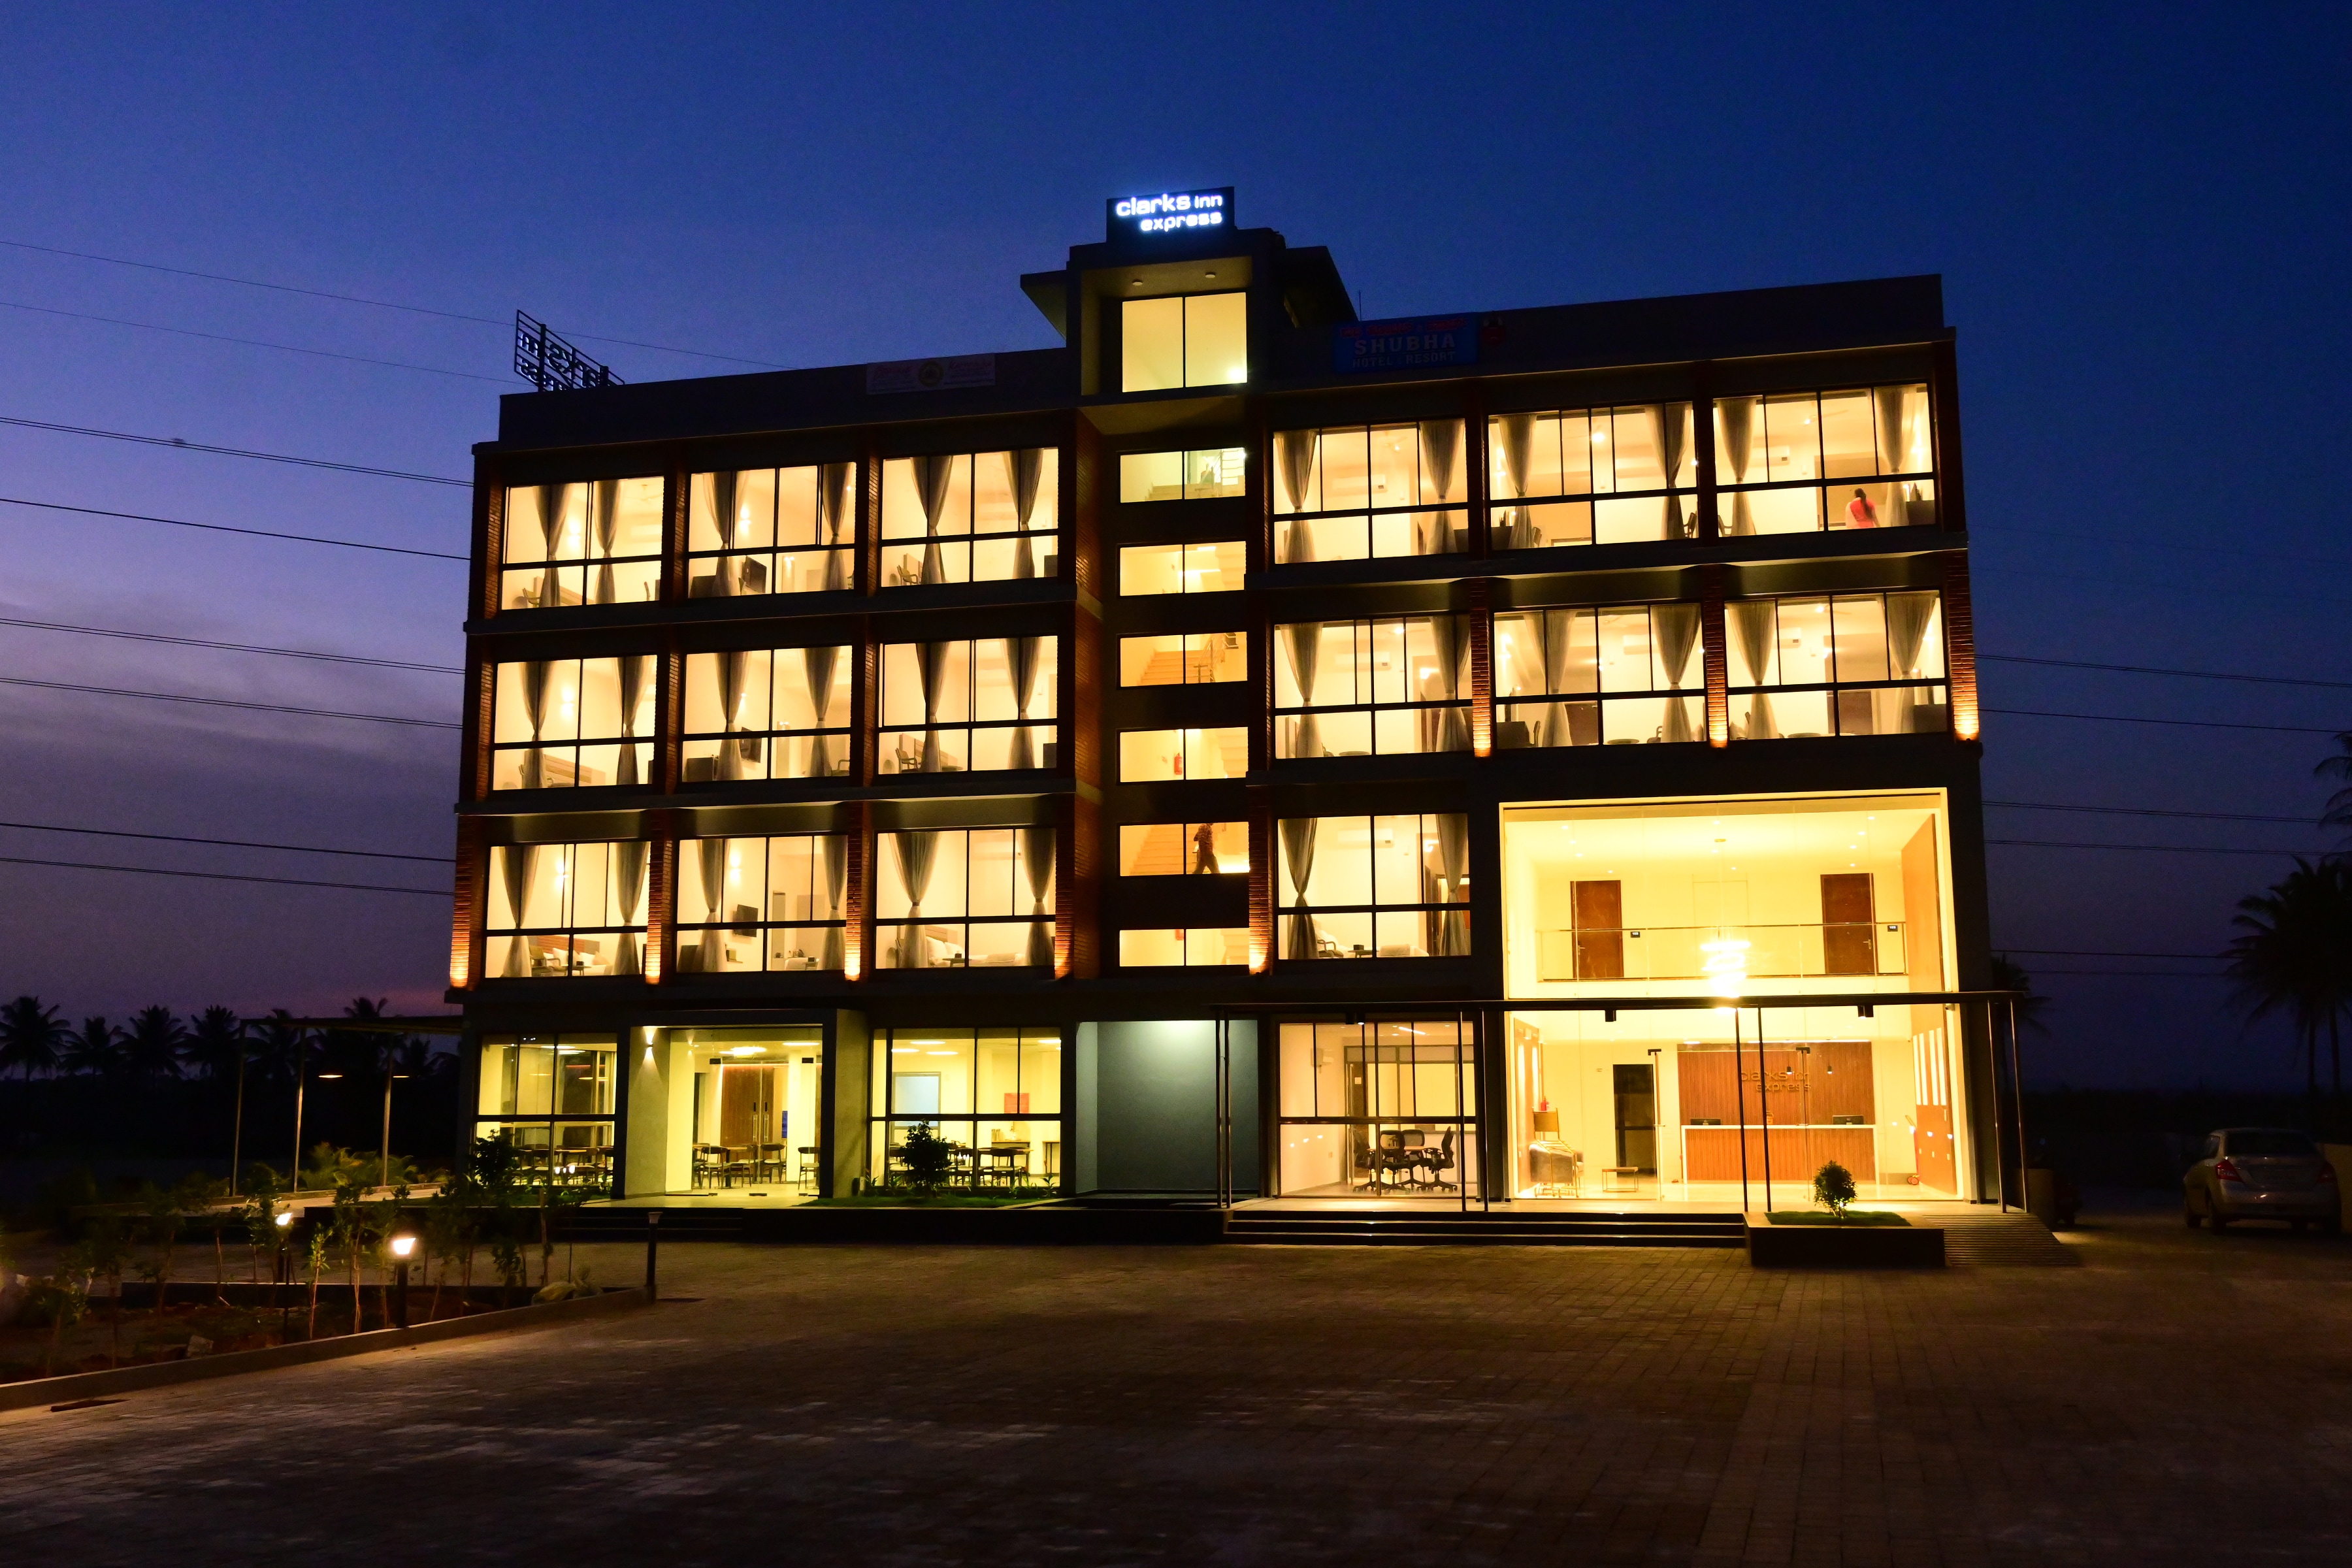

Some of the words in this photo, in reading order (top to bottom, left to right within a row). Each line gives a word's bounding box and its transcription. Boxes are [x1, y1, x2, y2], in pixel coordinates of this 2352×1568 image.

[1116, 193, 1190, 217] clarks
[1194, 195, 1222, 209] inn
[1140, 211, 1222, 232] express
[1354, 333, 1456, 355] SHUBHA
[1352, 356, 1393, 368] HOTEL
[1405, 351, 1456, 365] RESORT
